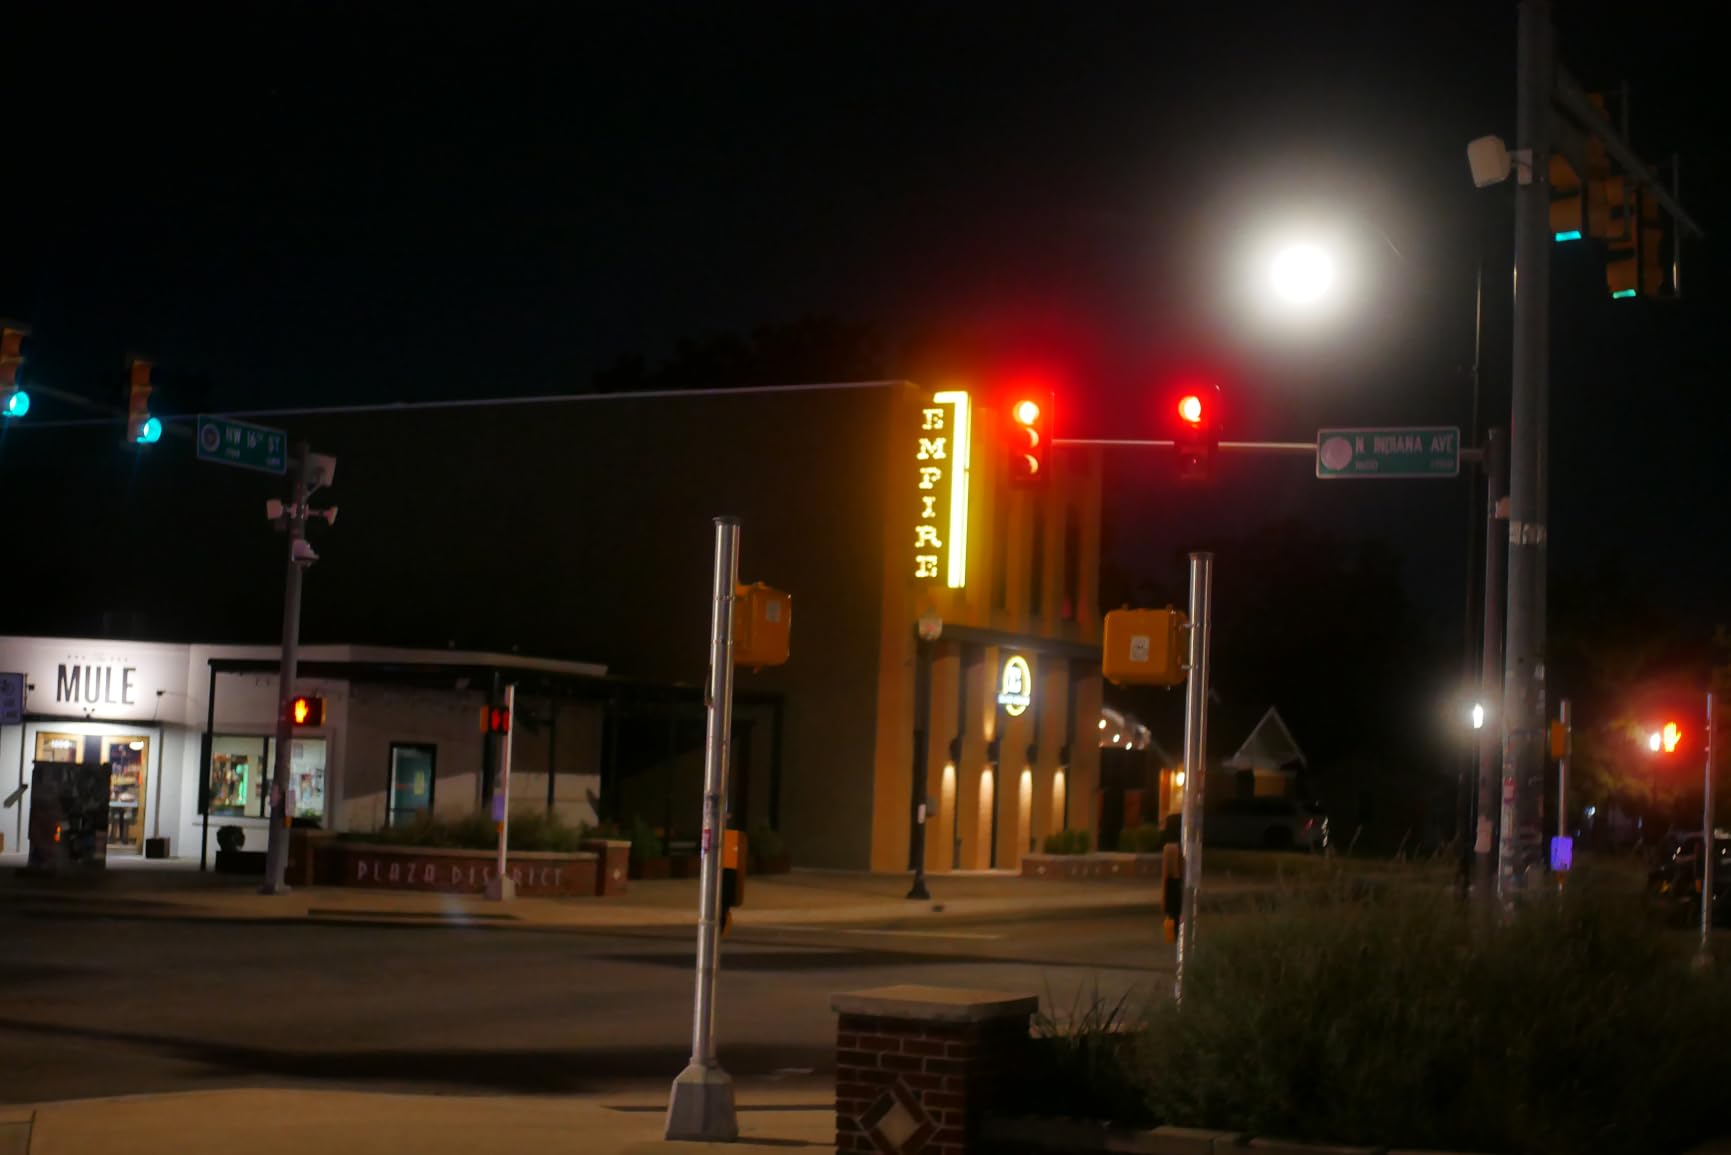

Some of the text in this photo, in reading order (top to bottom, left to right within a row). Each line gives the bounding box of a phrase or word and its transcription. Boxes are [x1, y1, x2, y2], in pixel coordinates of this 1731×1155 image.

[1354, 433, 1454, 455] N INDIANA AVE
[914, 408, 946, 579] EMPIRE
[56, 664, 137, 704] MULE
[357, 859, 564, 887] PLAZA DISRICT
